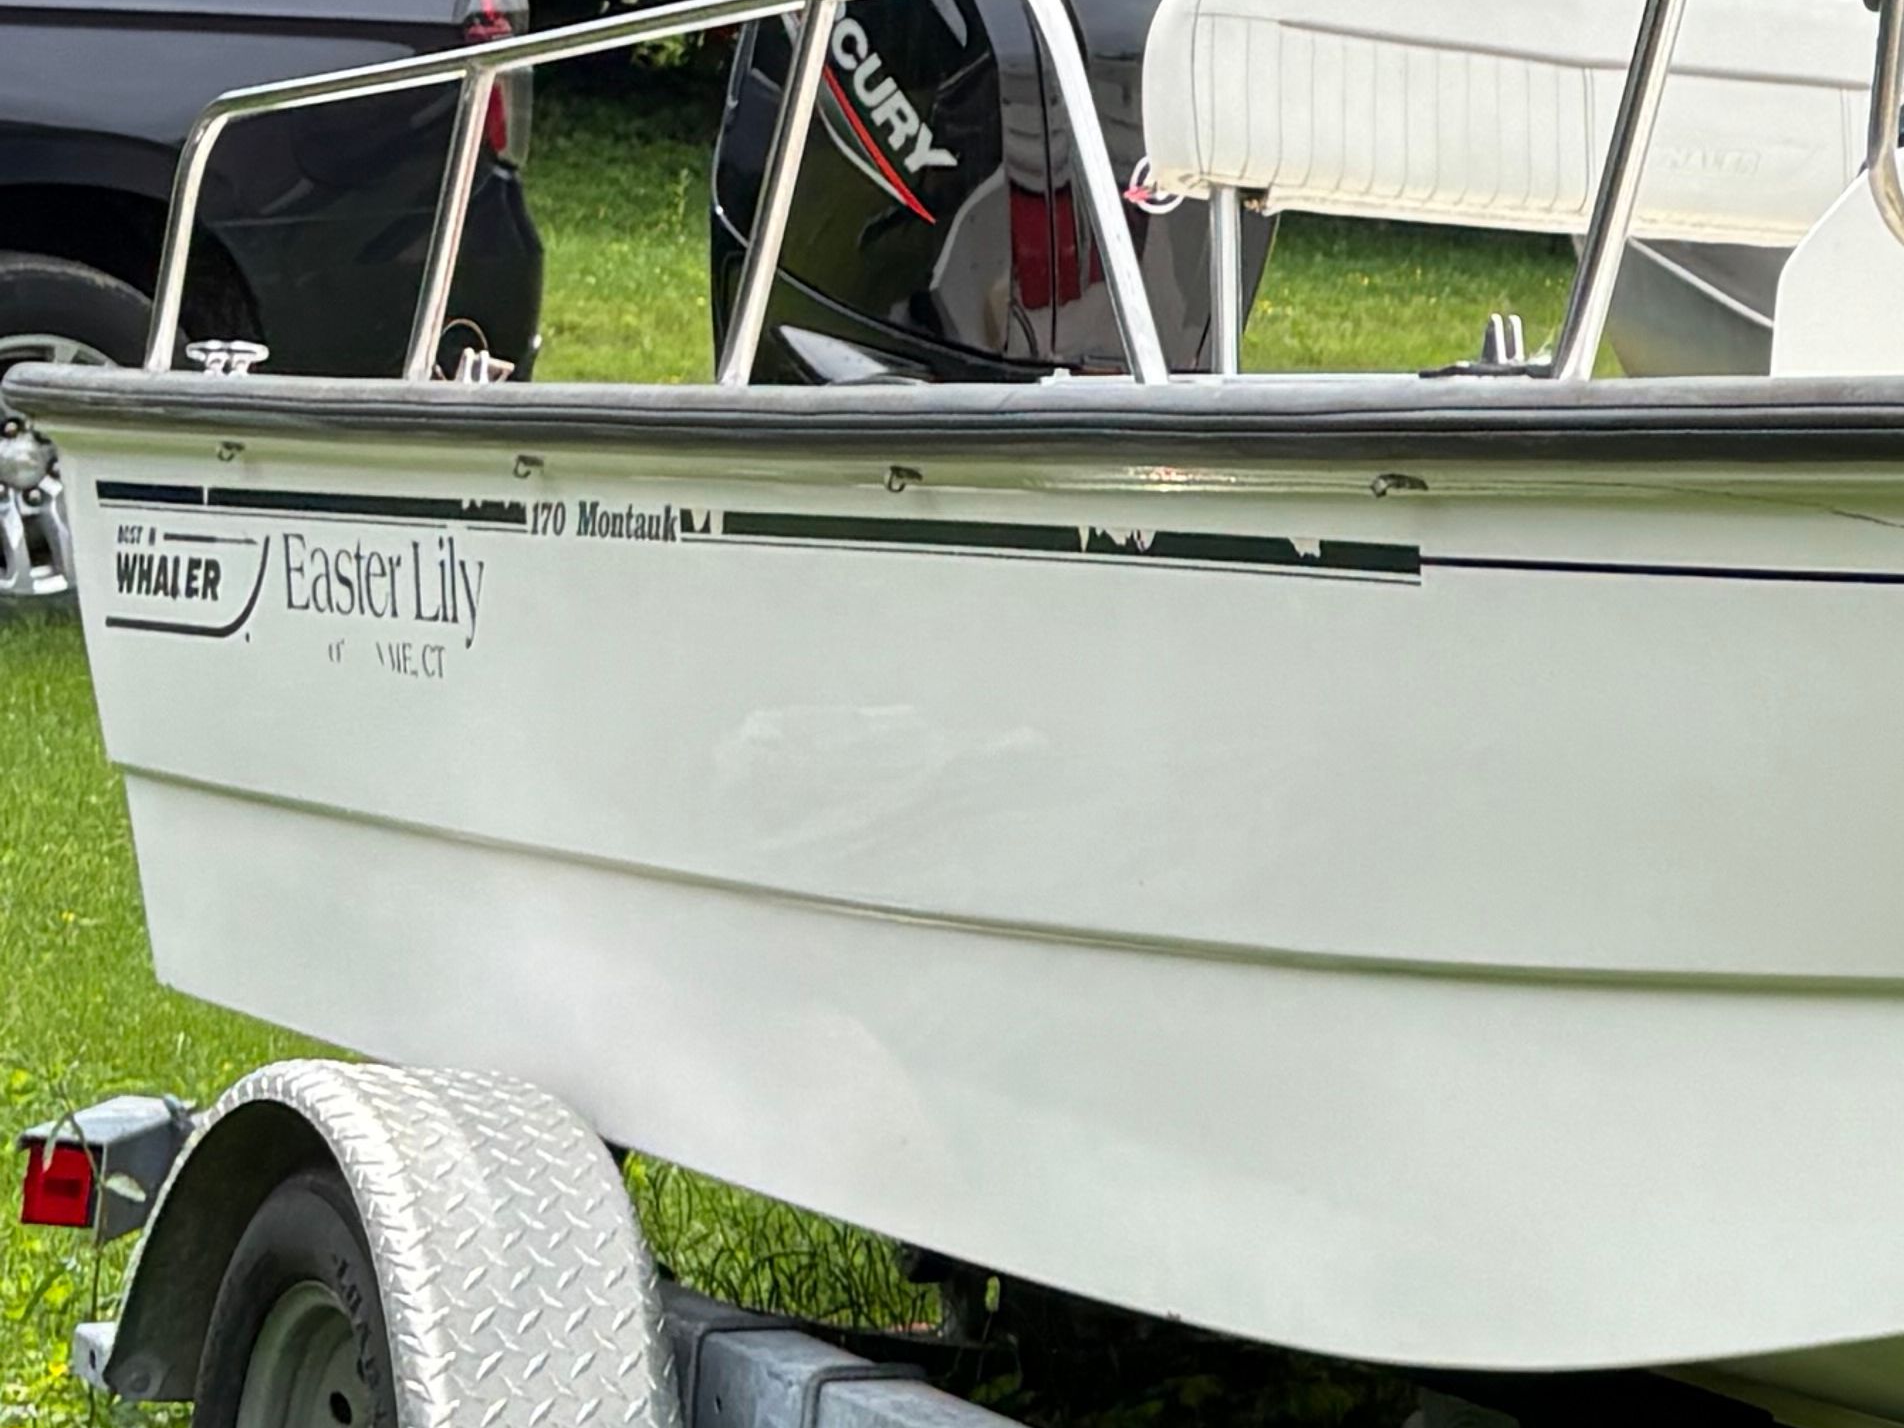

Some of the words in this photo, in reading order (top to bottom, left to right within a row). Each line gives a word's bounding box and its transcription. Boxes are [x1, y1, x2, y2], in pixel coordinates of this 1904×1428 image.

[530, 501, 567, 537] 170
[575, 499, 679, 544] Montauk
[283, 532, 402, 619] Easter
[412, 535, 485, 649] Lily
